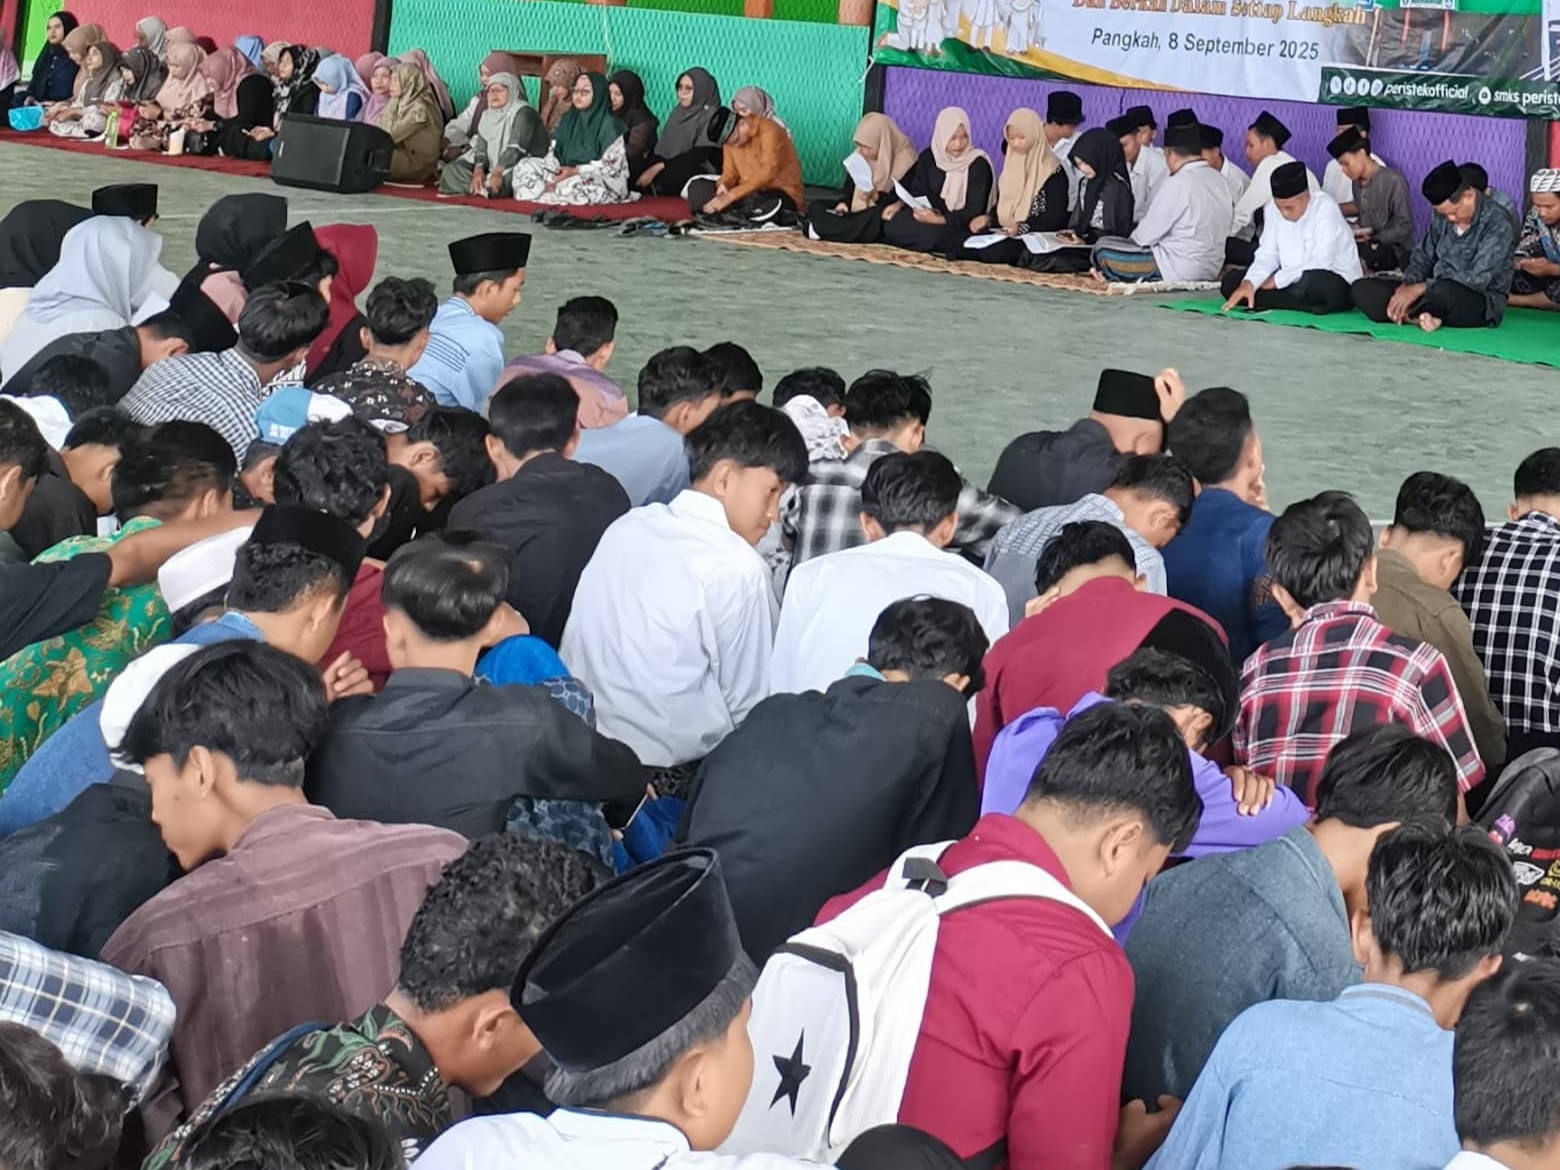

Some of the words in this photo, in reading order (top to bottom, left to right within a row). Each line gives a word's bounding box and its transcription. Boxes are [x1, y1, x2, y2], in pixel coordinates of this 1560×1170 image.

[1287, 0, 1367, 27] Langkah
[1091, 28, 1162, 52] Pangkah,
[1168, 32, 1179, 50] 8
[1184, 33, 1275, 56] September
[1279, 40, 1319, 60] 2025
[1383, 82, 1470, 100] peristekofficial
[1493, 88, 1519, 103] smks
